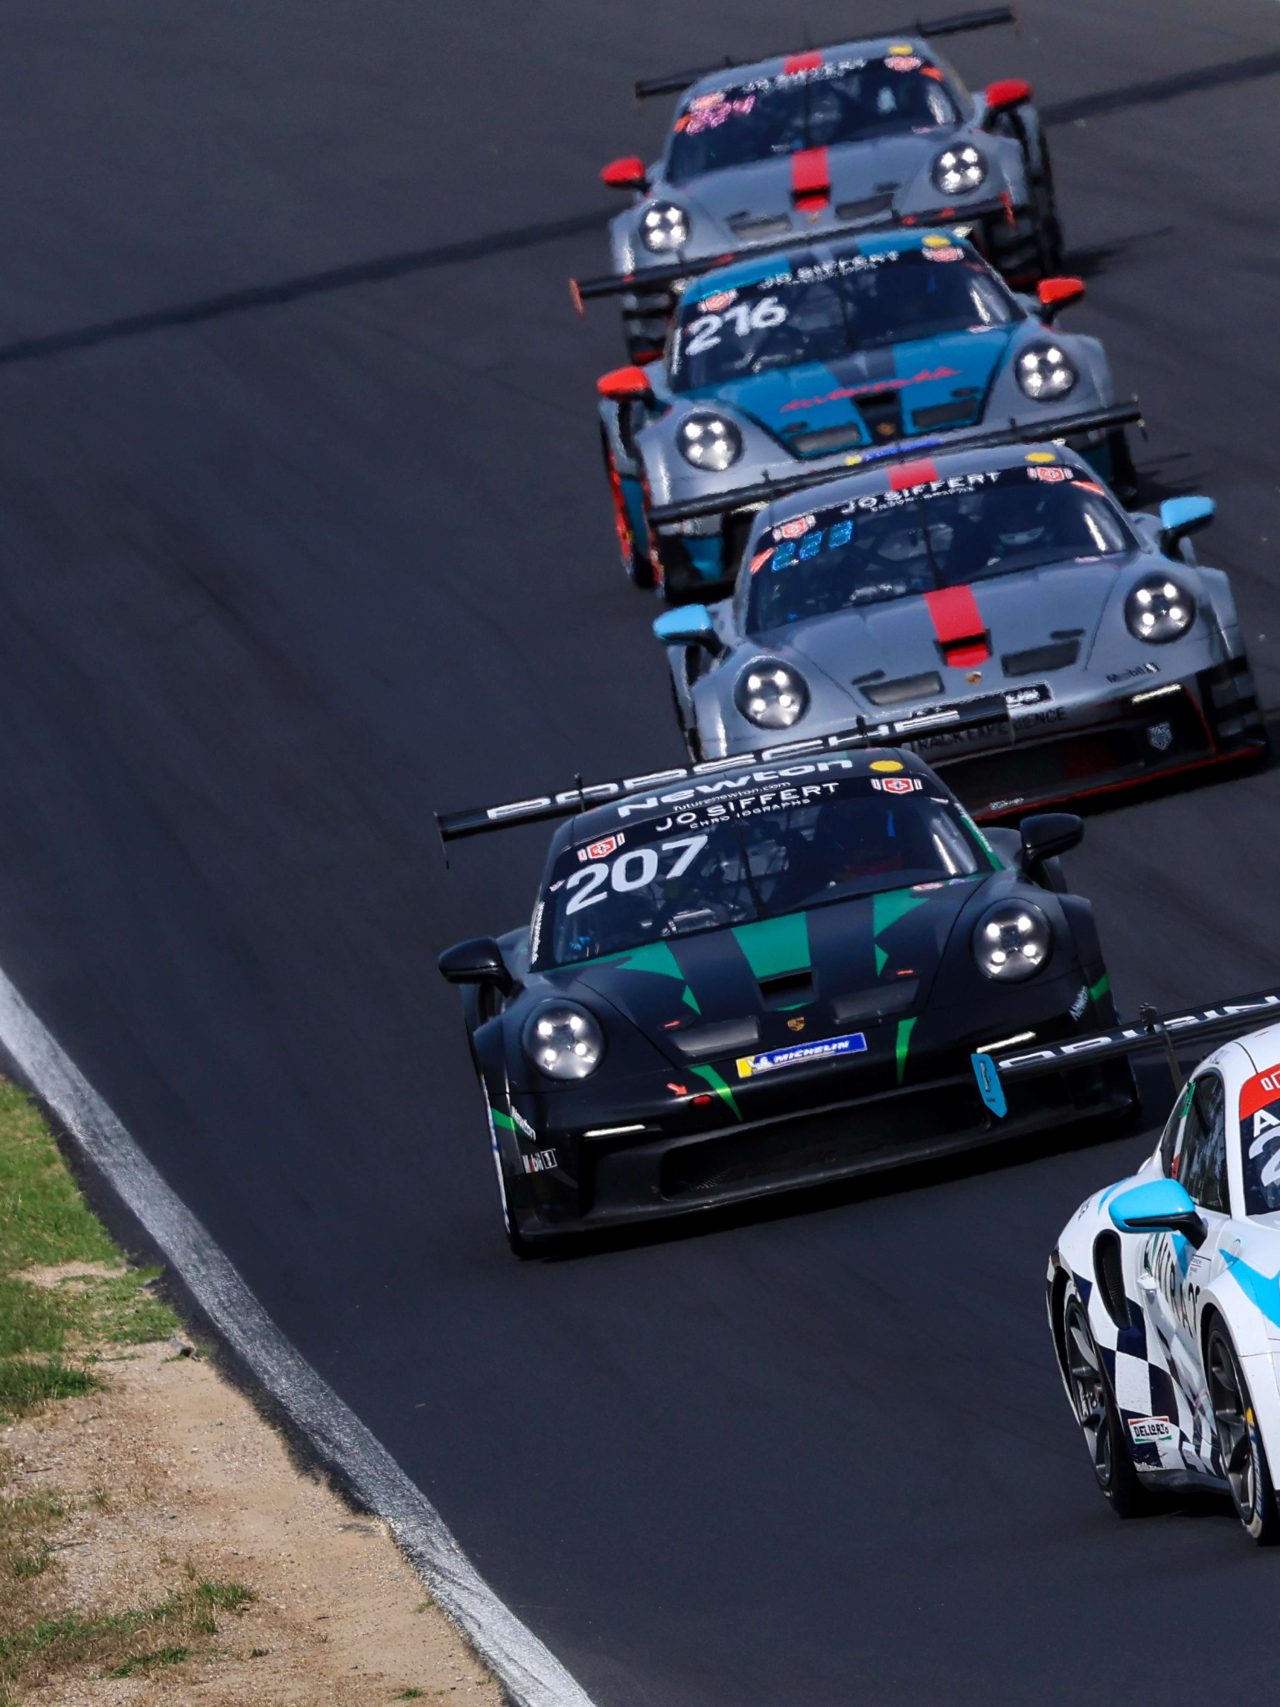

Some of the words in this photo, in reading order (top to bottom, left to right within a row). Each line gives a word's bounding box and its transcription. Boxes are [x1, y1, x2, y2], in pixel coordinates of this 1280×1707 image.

[685, 296, 788, 356] 216
[841, 496, 878, 515] JO
[884, 471, 1002, 501] SIFFERT
[488, 709, 959, 820] PORSCHE
[618, 759, 853, 818] Newton
[656, 812, 696, 832] JO
[706, 783, 840, 817] SIFFERT
[673, 782, 791, 811] futurenewton.com
[566, 834, 708, 916] 207
[774, 1041, 850, 1063] MICHELIN
